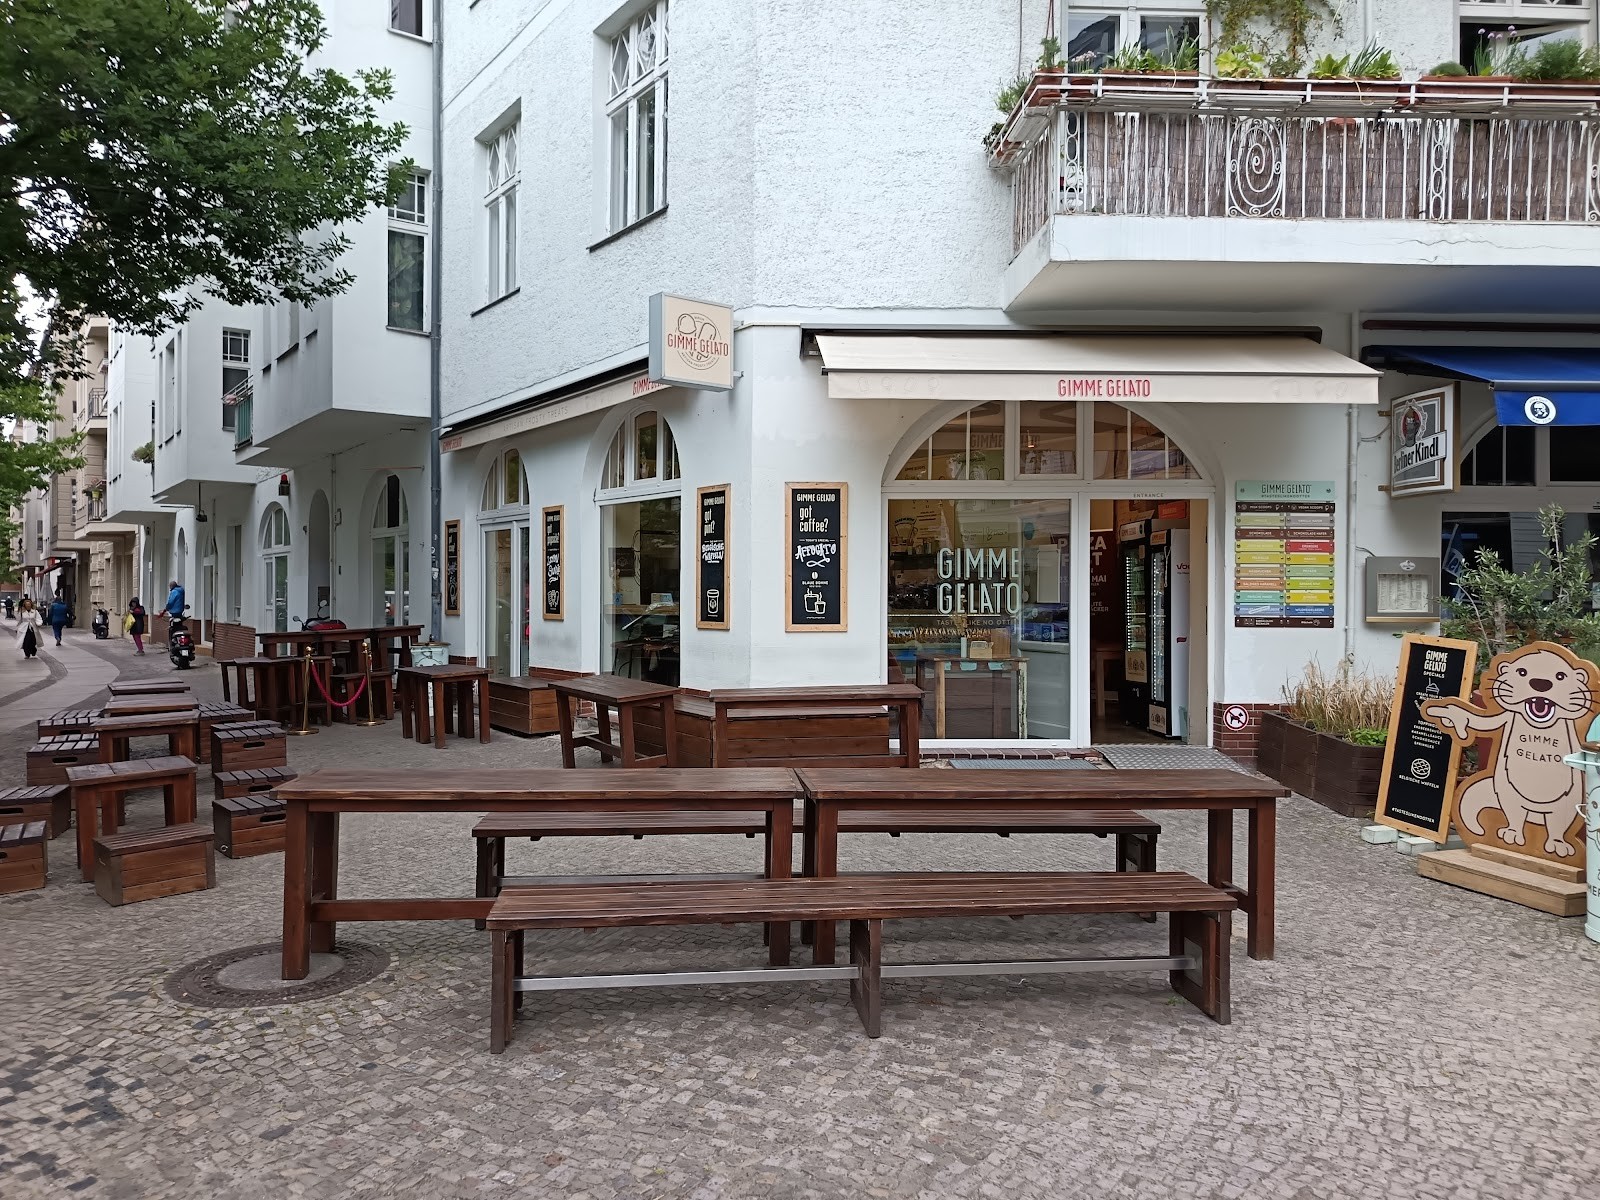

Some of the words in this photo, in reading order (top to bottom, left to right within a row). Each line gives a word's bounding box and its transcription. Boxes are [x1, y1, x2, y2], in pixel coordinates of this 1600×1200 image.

[667, 333, 697, 351] GIMME
[700, 338, 729, 357] GELATO
[1058, 379, 1102, 398] GIMME
[1106, 379, 1151, 398] GELATO
[1394, 450, 1415, 474] Berliner
[1415, 436, 1439, 463] Kindl
[1261, 484, 1285, 494] GIMME
[1286, 484, 1311, 494] GELATO
[796, 493, 816, 502] GIMME
[816, 493, 836, 502] GELATO
[799, 505, 813, 521] got
[799, 518, 829, 532] coffee?
[936, 547, 1020, 580] GIMME
[936, 582, 1021, 615] GELATO
[1425, 649, 1449, 663] GIMME
[1423, 659, 1447, 673] GELATO
[1423, 670, 1445, 679] SPECIALS
[1417, 719, 1438, 729] TOPPING
[1519, 734, 1559, 748] GIMME
[1516, 748, 1562, 763] GELATO
[1398, 774, 1420, 785] BELGISCHE
[1420, 780, 1440, 789] WAFFELN
